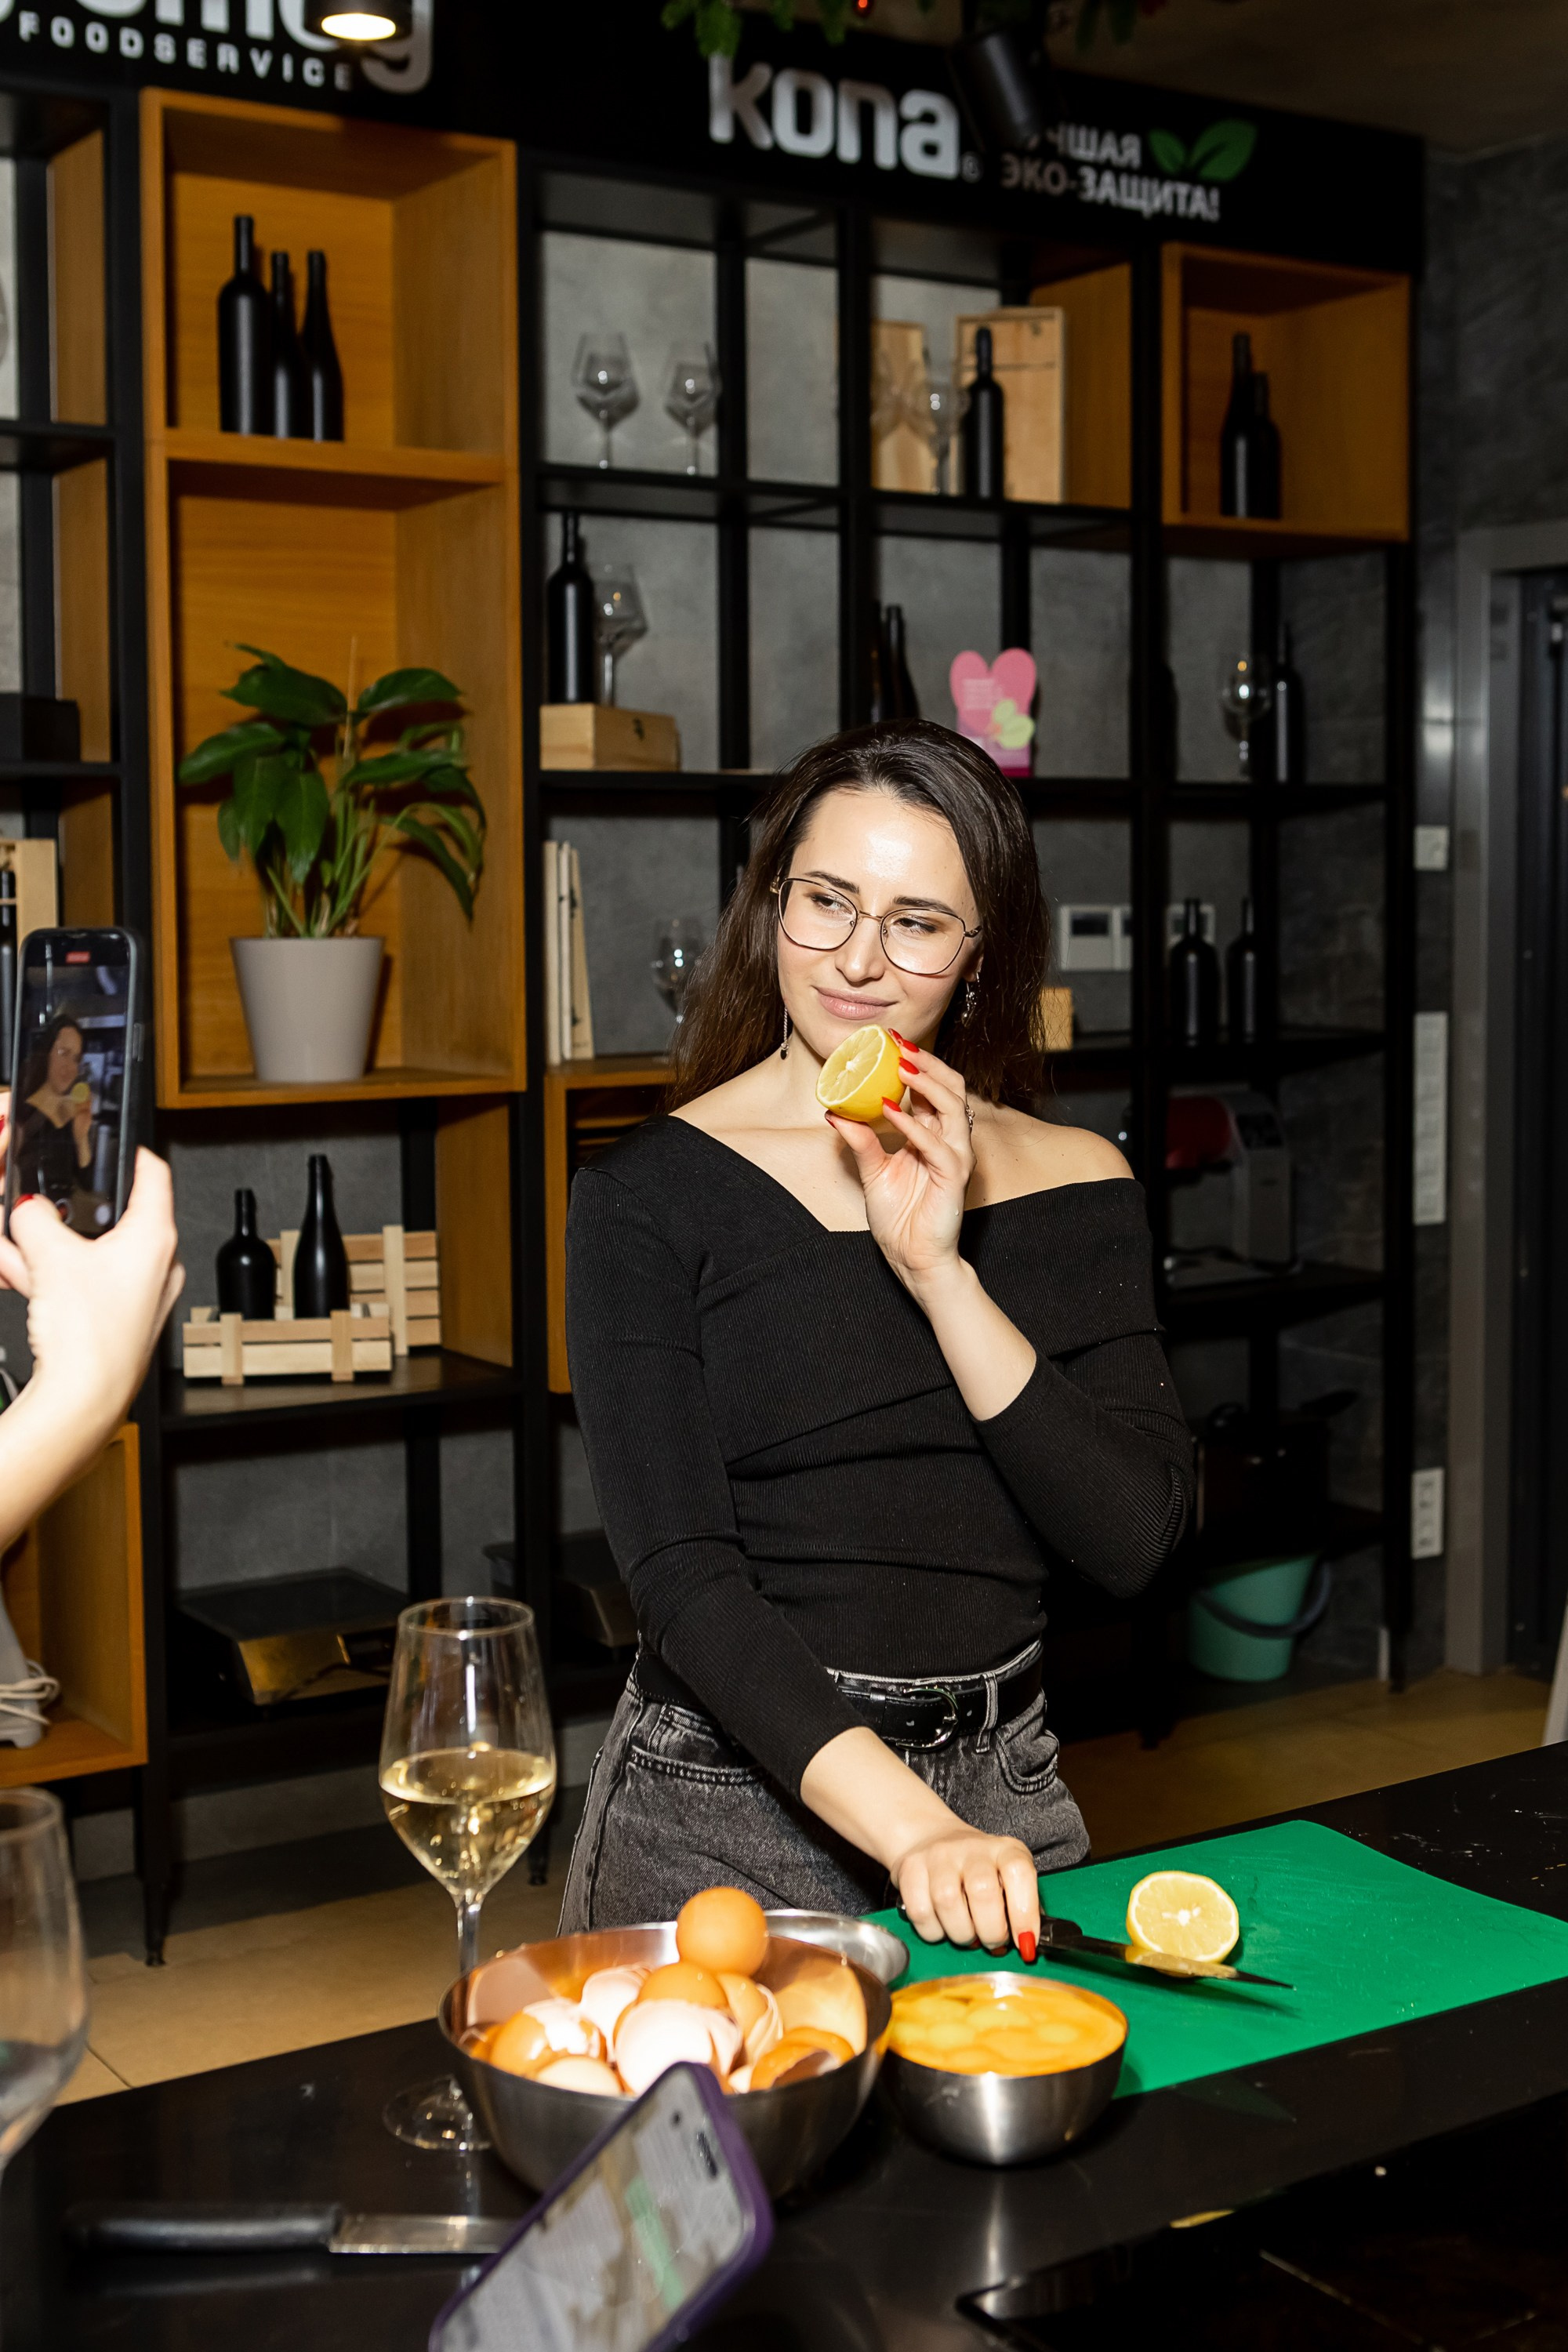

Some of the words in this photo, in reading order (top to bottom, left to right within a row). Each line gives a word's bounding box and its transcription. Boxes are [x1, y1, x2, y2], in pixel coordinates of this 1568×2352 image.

[20, 10, 350, 91] FOODSERVICE
[709, 53, 960, 180] kona
[1027, 120, 1142, 171] ЧШАЯ
[999, 151, 1222, 224] ЭКО-ЗАЩИТА!
